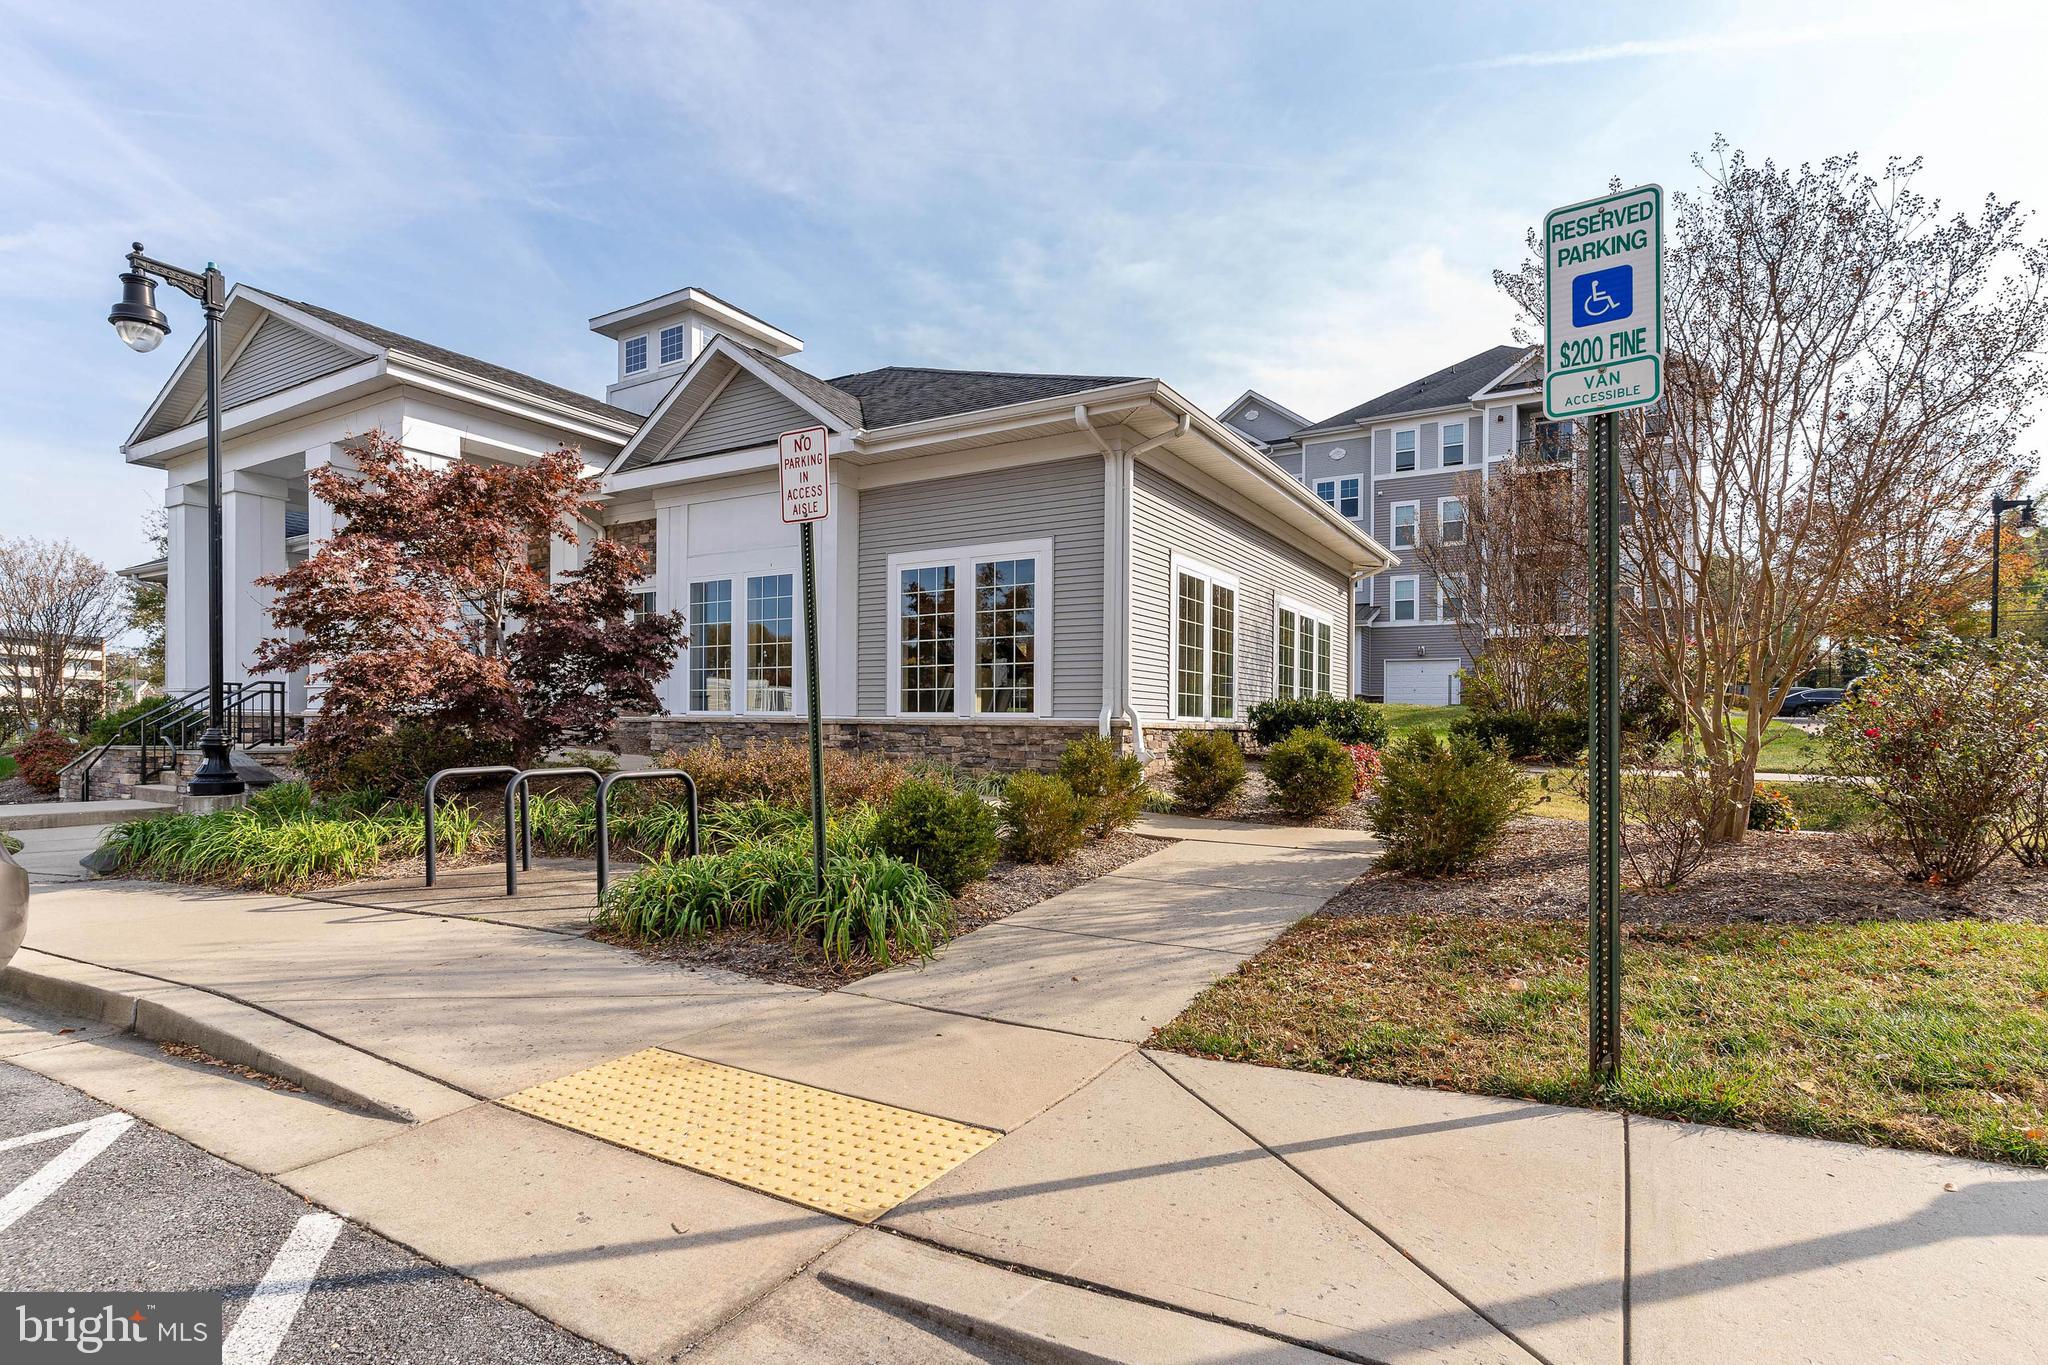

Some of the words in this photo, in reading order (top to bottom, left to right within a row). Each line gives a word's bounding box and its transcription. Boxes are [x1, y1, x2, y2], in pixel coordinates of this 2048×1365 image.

[1552, 201, 1653, 243] RESERVED
[1558, 229, 1648, 268] PARKING
[1560, 335, 1603, 369] $200
[1609, 327, 1647, 359] FINE
[1584, 371, 1620, 389] VAN
[1565, 385, 1641, 407] ACCESSIBLE
[794, 437, 811, 452] NO
[784, 453, 822, 470] PARKING
[800, 471, 808, 483] IN
[787, 485, 822, 500] ACCESS
[793, 502, 818, 515] AISLE
